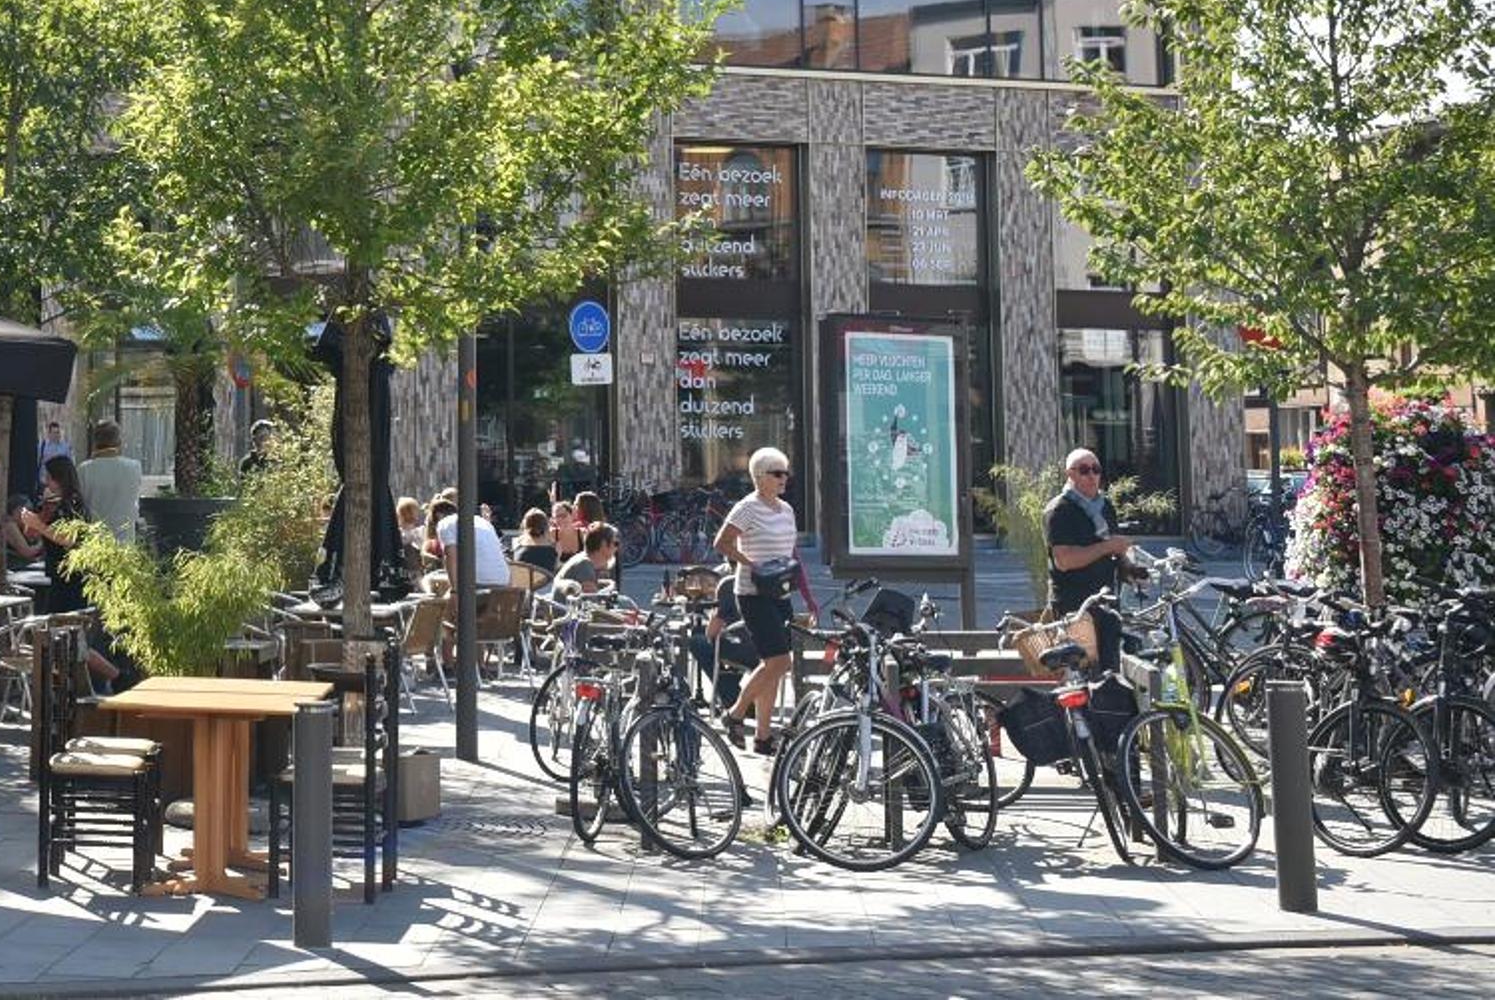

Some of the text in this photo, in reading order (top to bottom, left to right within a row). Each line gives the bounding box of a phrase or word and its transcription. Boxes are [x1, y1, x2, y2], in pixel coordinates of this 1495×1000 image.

[717, 162, 783, 184] bezoek
[726, 193, 771, 208] meer
[717, 319, 784, 342] bezoek
[679, 347, 771, 370] zegt meer
[680, 369, 717, 389] dan
[680, 392, 755, 415] duizend
[681, 417, 745, 440] stickers
